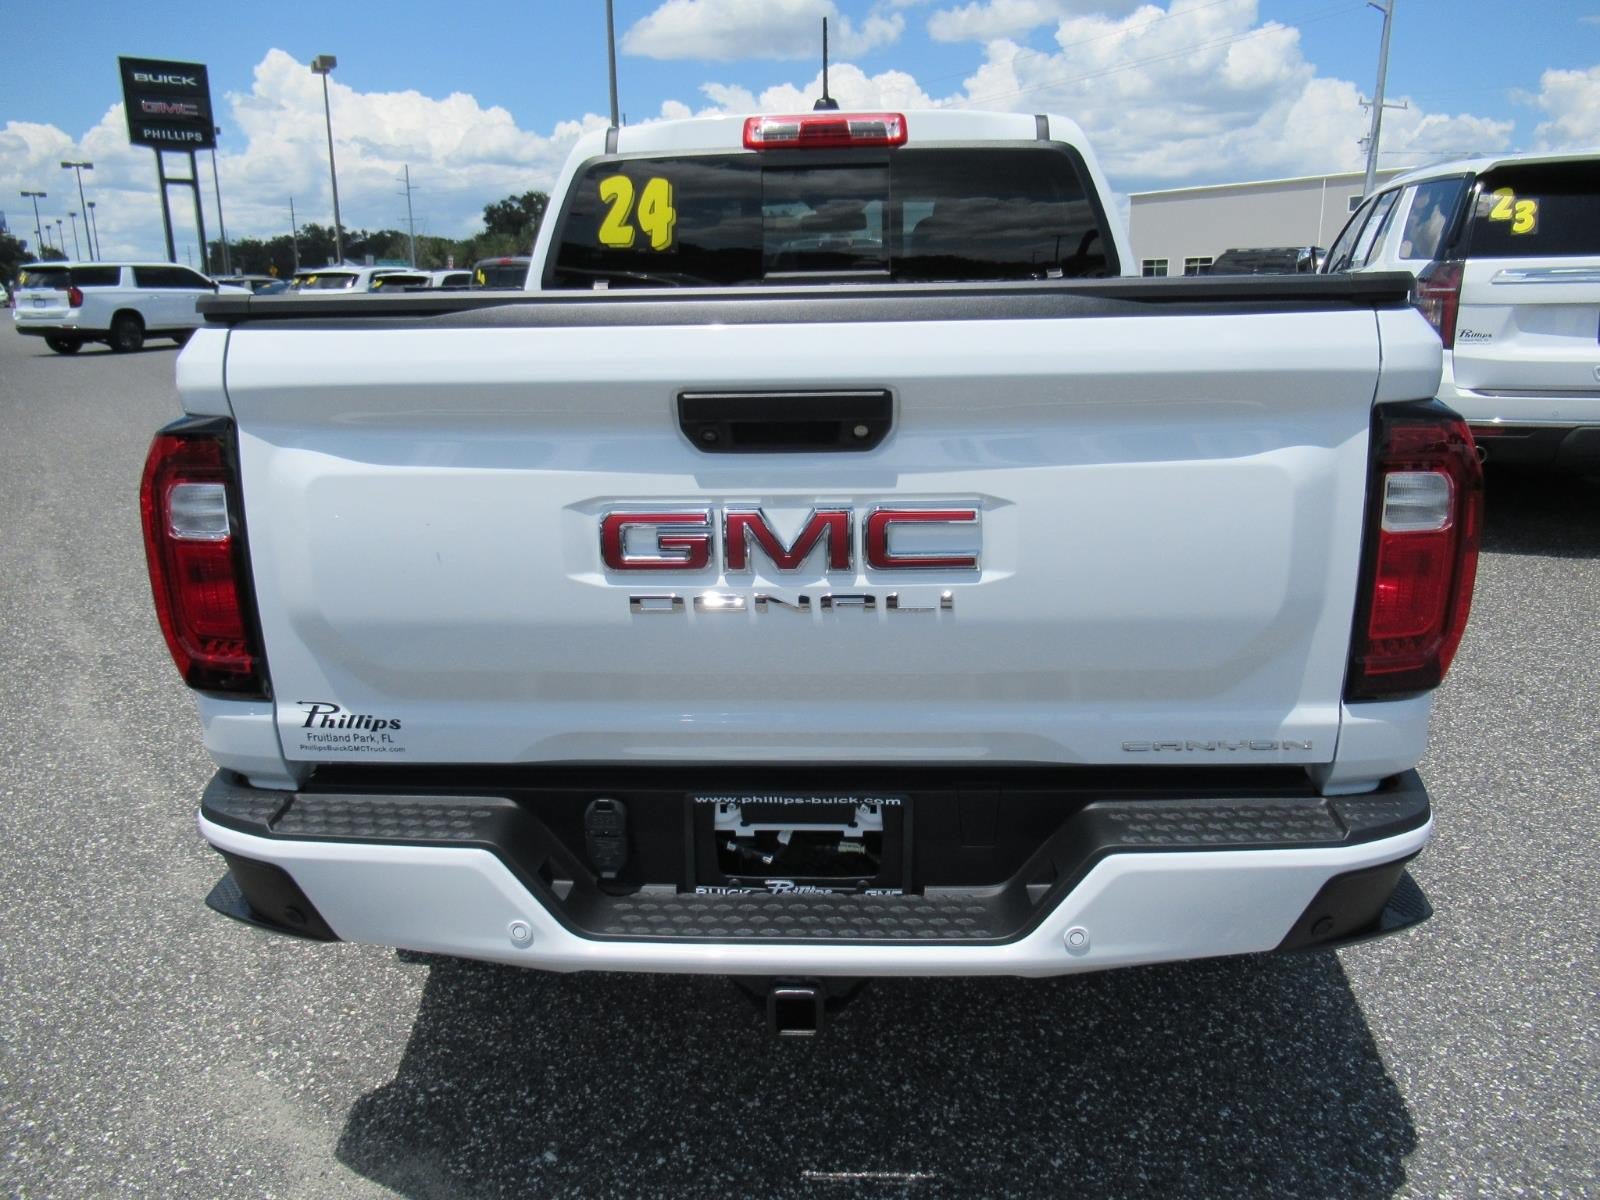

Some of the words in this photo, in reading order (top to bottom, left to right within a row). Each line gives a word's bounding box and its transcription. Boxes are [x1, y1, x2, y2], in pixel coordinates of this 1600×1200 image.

[134, 73, 198, 86] BUICK
[142, 100, 199, 116] GMC
[143, 128, 203, 142] PHILLIPS
[599, 175, 677, 251] 24
[1490, 187, 1537, 234] 23
[600, 506, 982, 575] GMC
[629, 593, 954, 614] DENALI
[296, 700, 402, 732] Phillips
[306, 732, 351, 743] Fruitland
[353, 733, 379, 744] Park,
[381, 734, 394, 743] FL
[1122, 740, 1312, 751] CANYON
[299, 744, 406, 753] PhillipsBuickGMCTruck.com
[694, 796, 902, 806] www.phillips-buick.com
